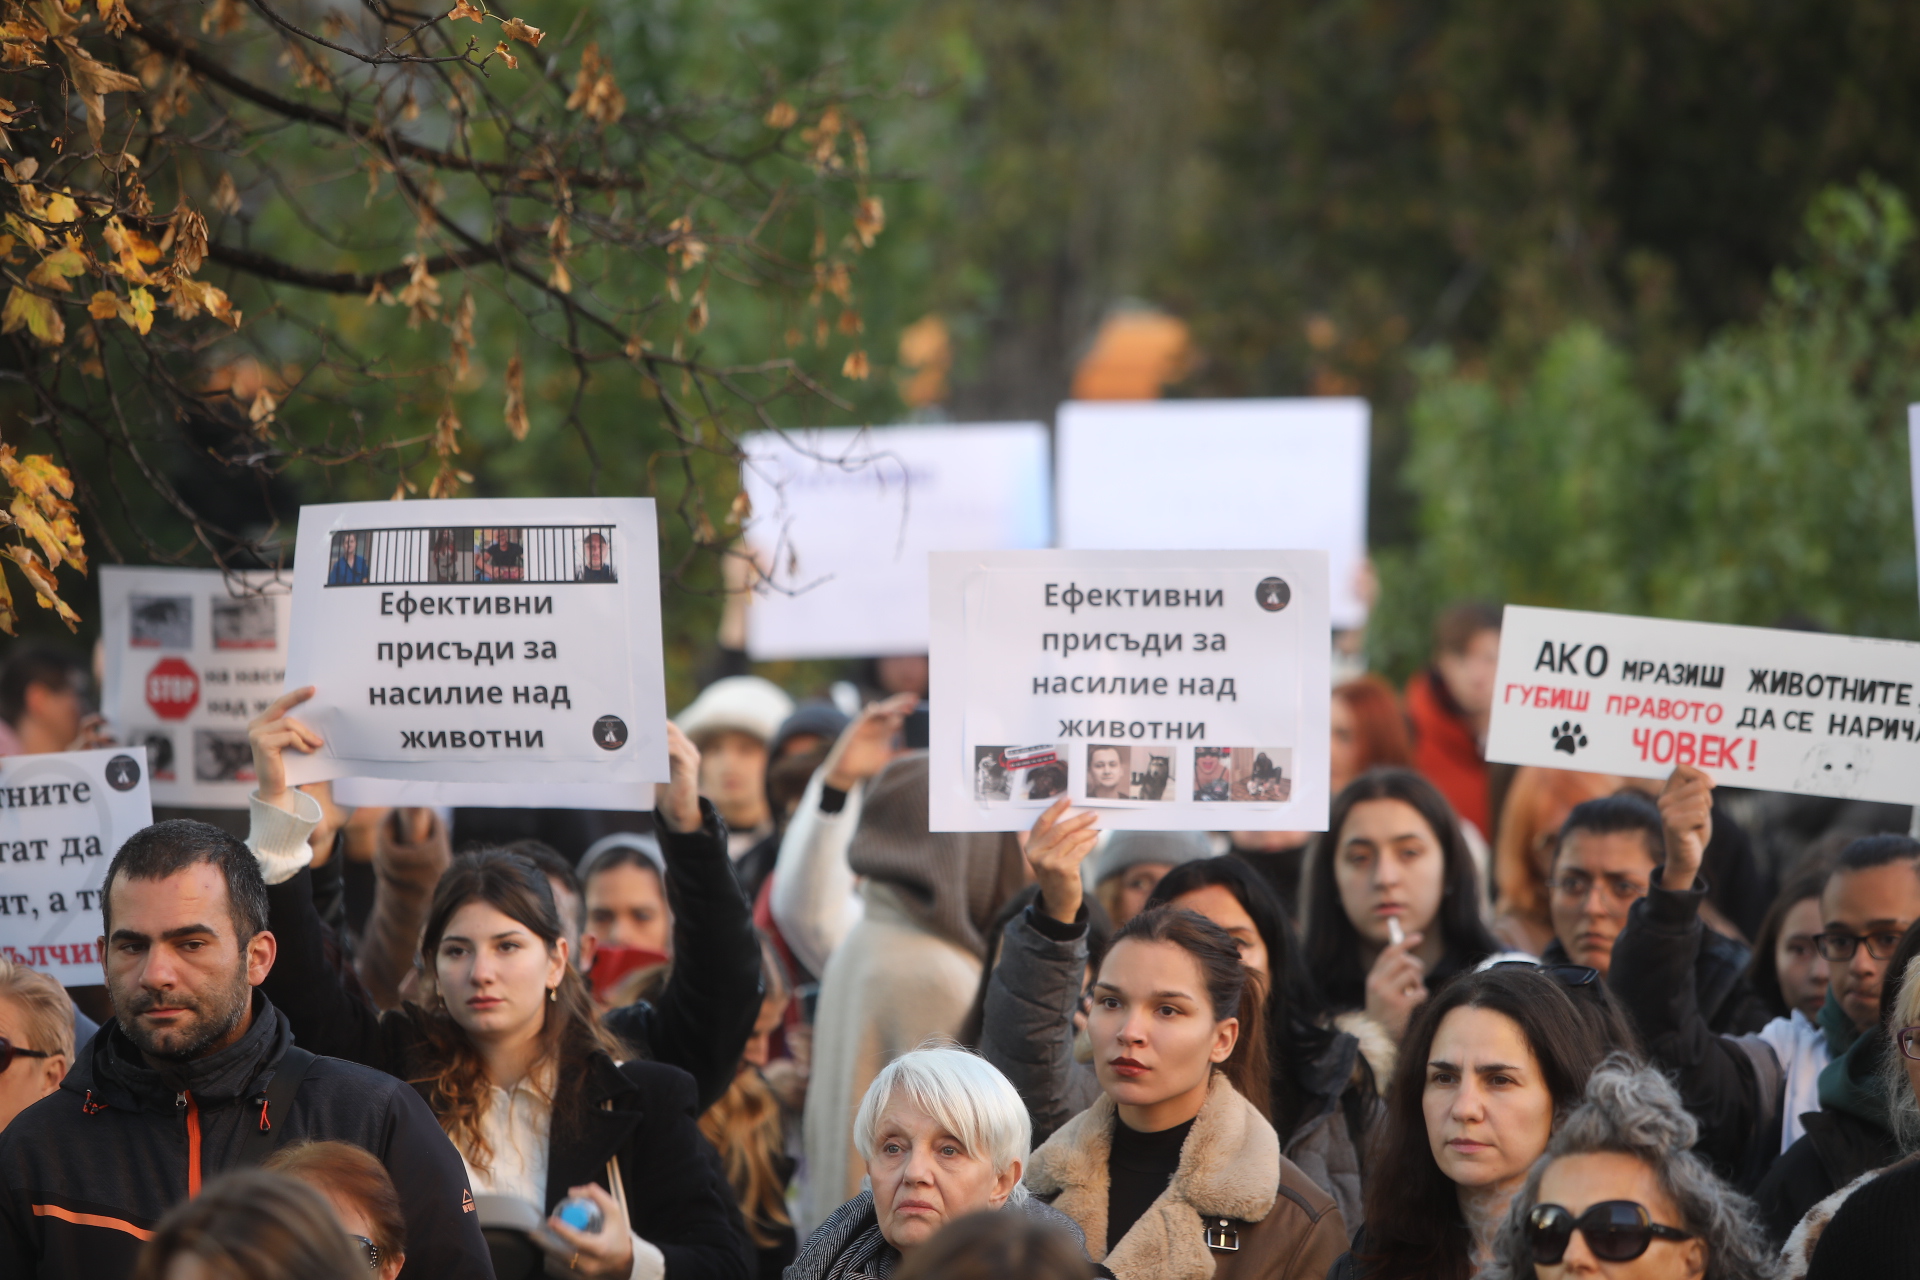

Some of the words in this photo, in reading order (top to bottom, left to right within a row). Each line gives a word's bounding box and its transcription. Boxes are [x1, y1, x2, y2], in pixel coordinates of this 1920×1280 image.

[380, 590, 553, 623] Ефективни
[1044, 582, 1224, 614] Ефективни
[377, 640, 514, 668] присъди
[523, 639, 558, 660] за
[1042, 632, 1183, 658] присъди
[1192, 632, 1227, 652] за
[1534, 640, 1609, 678] АКО
[1621, 660, 1725, 689] МРАЗИШ
[150, 674, 195, 704] STOP
[368, 685, 503, 706] насилие
[512, 684, 572, 710] над
[1033, 675, 1168, 695] насилие
[1178, 676, 1237, 702] над
[1503, 683, 1591, 712] ГУБИШ
[1605, 694, 1724, 724] ПРАВОТО
[1736, 707, 1776, 730] ДА
[1783, 710, 1814, 733] СЕ
[400, 729, 544, 749] животни
[1058, 719, 1205, 740] животни
[1632, 727, 1758, 772] ЧОВЕК!
[60, 834, 103, 866] да
[49, 891, 68, 914] а
